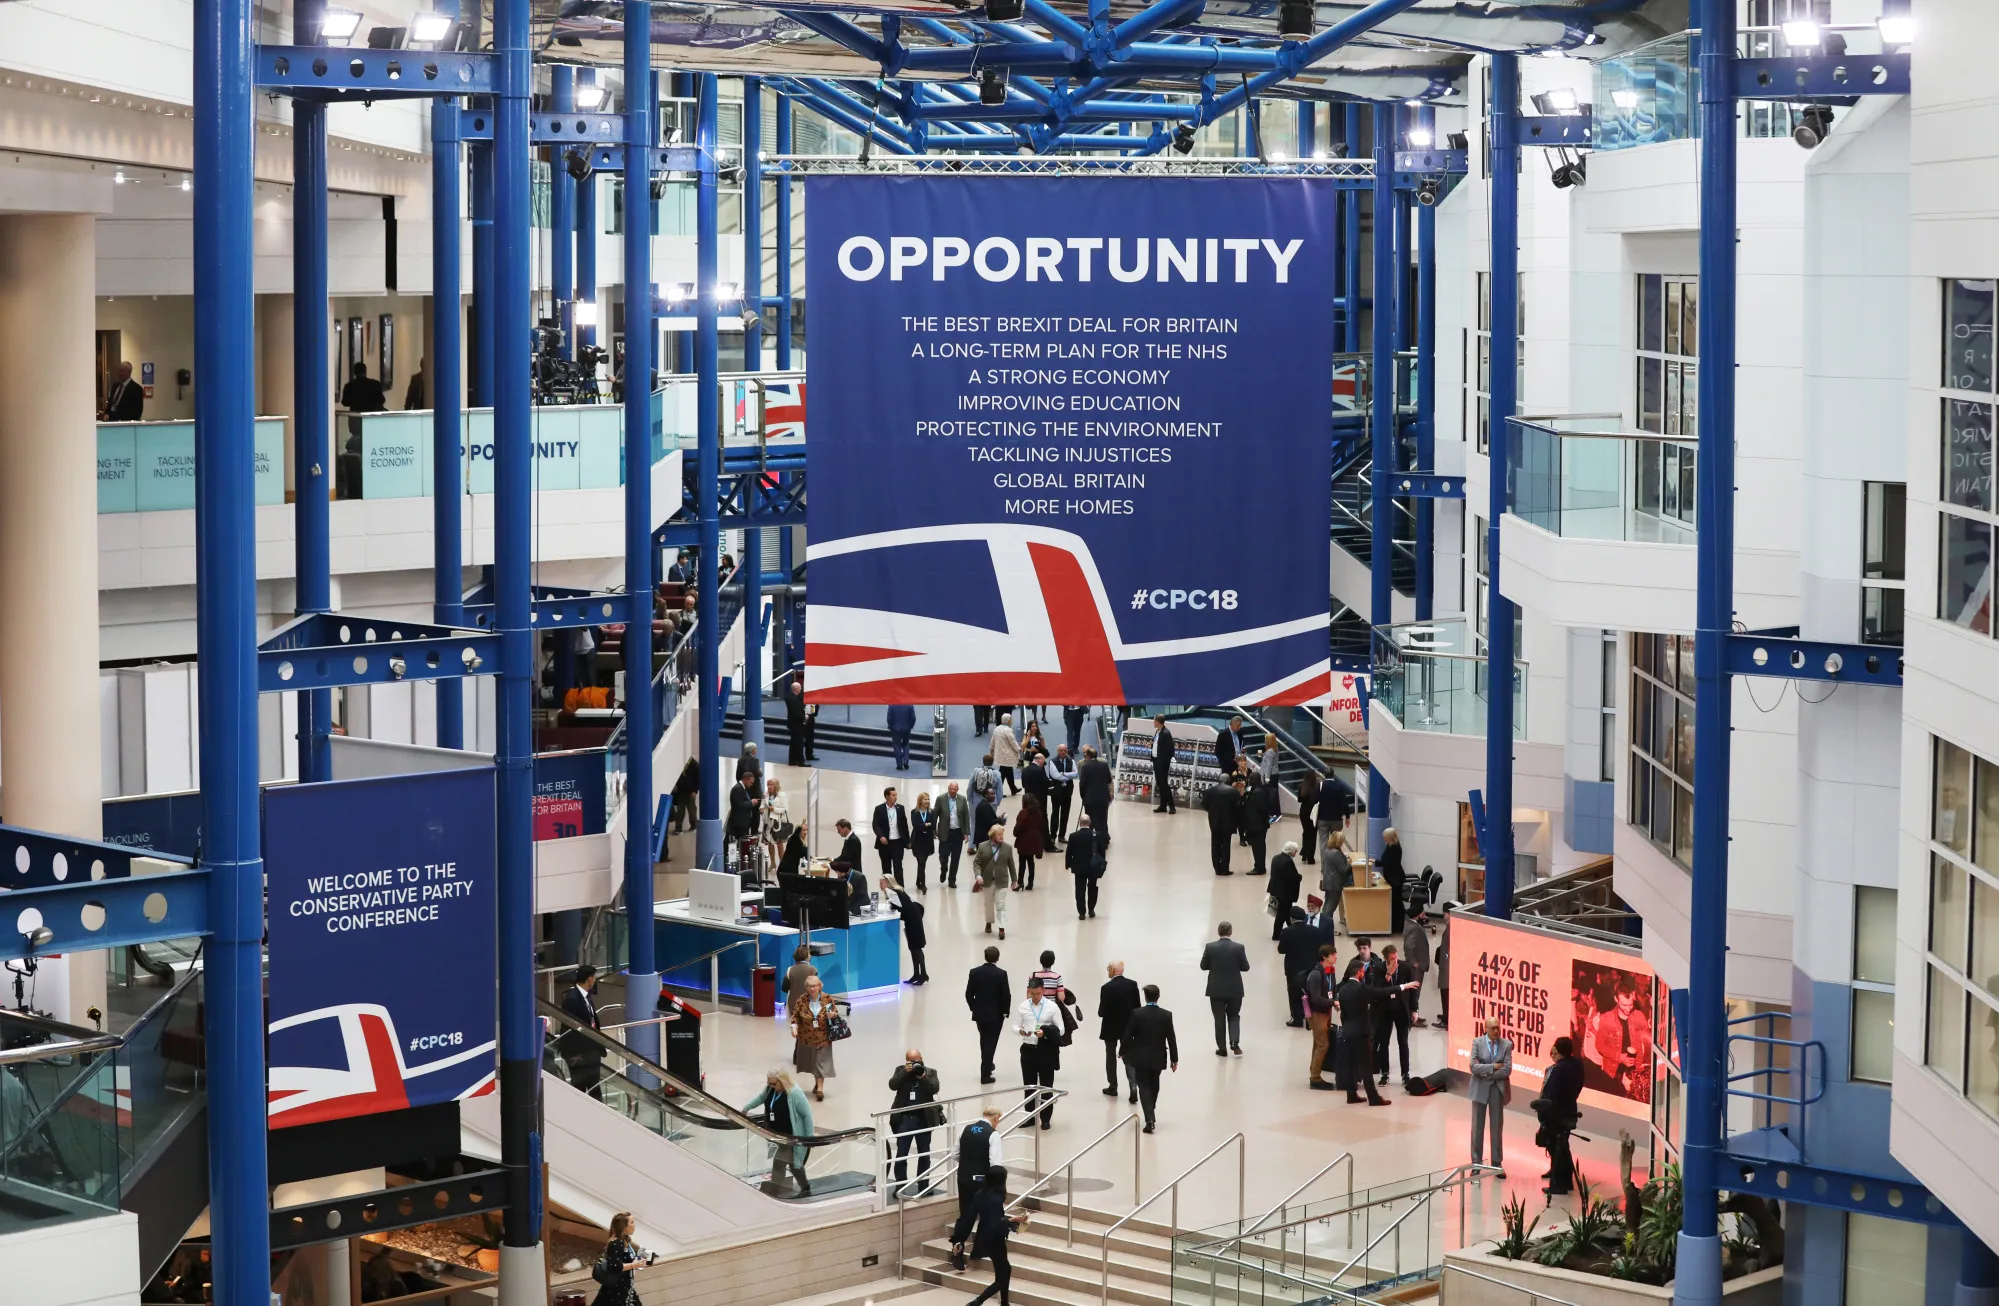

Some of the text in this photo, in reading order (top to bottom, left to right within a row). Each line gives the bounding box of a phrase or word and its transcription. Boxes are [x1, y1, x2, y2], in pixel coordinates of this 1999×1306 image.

[837, 235, 1305, 284] OPPORTUNITY
[901, 316, 1238, 334] THE BEST BREXIT DEAL FOR BRITAIN
[911, 343, 1228, 359] A LONG-TERM PLAN FOR THE NHS
[968, 369, 1171, 385] A STRONG ECONOMY
[958, 395, 1181, 411] IMPROVING EDUCATION
[916, 421, 1223, 438] PROTECTING THE ENVIRONMENT
[371, 446, 414, 456] A STRONG
[967, 447, 1172, 463] TACKLING INJUSTICES
[114, 457, 132, 468] THE
[157, 456, 196, 466] TACKLIN
[371, 457, 415, 468] ECONOMY
[153, 467, 196, 478] INJUSTIC
[994, 473, 1145, 489] GLOBAL BRITAIN
[1005, 499, 1134, 515] MORE HOMES
[1131, 589, 1239, 610] #CPC18
[537, 780, 576, 792] THE BEST
[561, 790, 582, 801] DEAL
[550, 802, 582, 814] BRITAIN
[104, 832, 150, 845] TACKLING
[308, 862, 456, 894] WELCOME TO THE
[289, 880, 474, 917] CONSERVATIVE PARTY
[326, 904, 439, 933] CONFERENCE
[1478, 951, 1541, 984] 44% OF
[1470, 972, 1549, 1011] EMPLOYEES
[1472, 997, 1545, 1034] IN THE PUB
[410, 1031, 463, 1051] #CPC18
